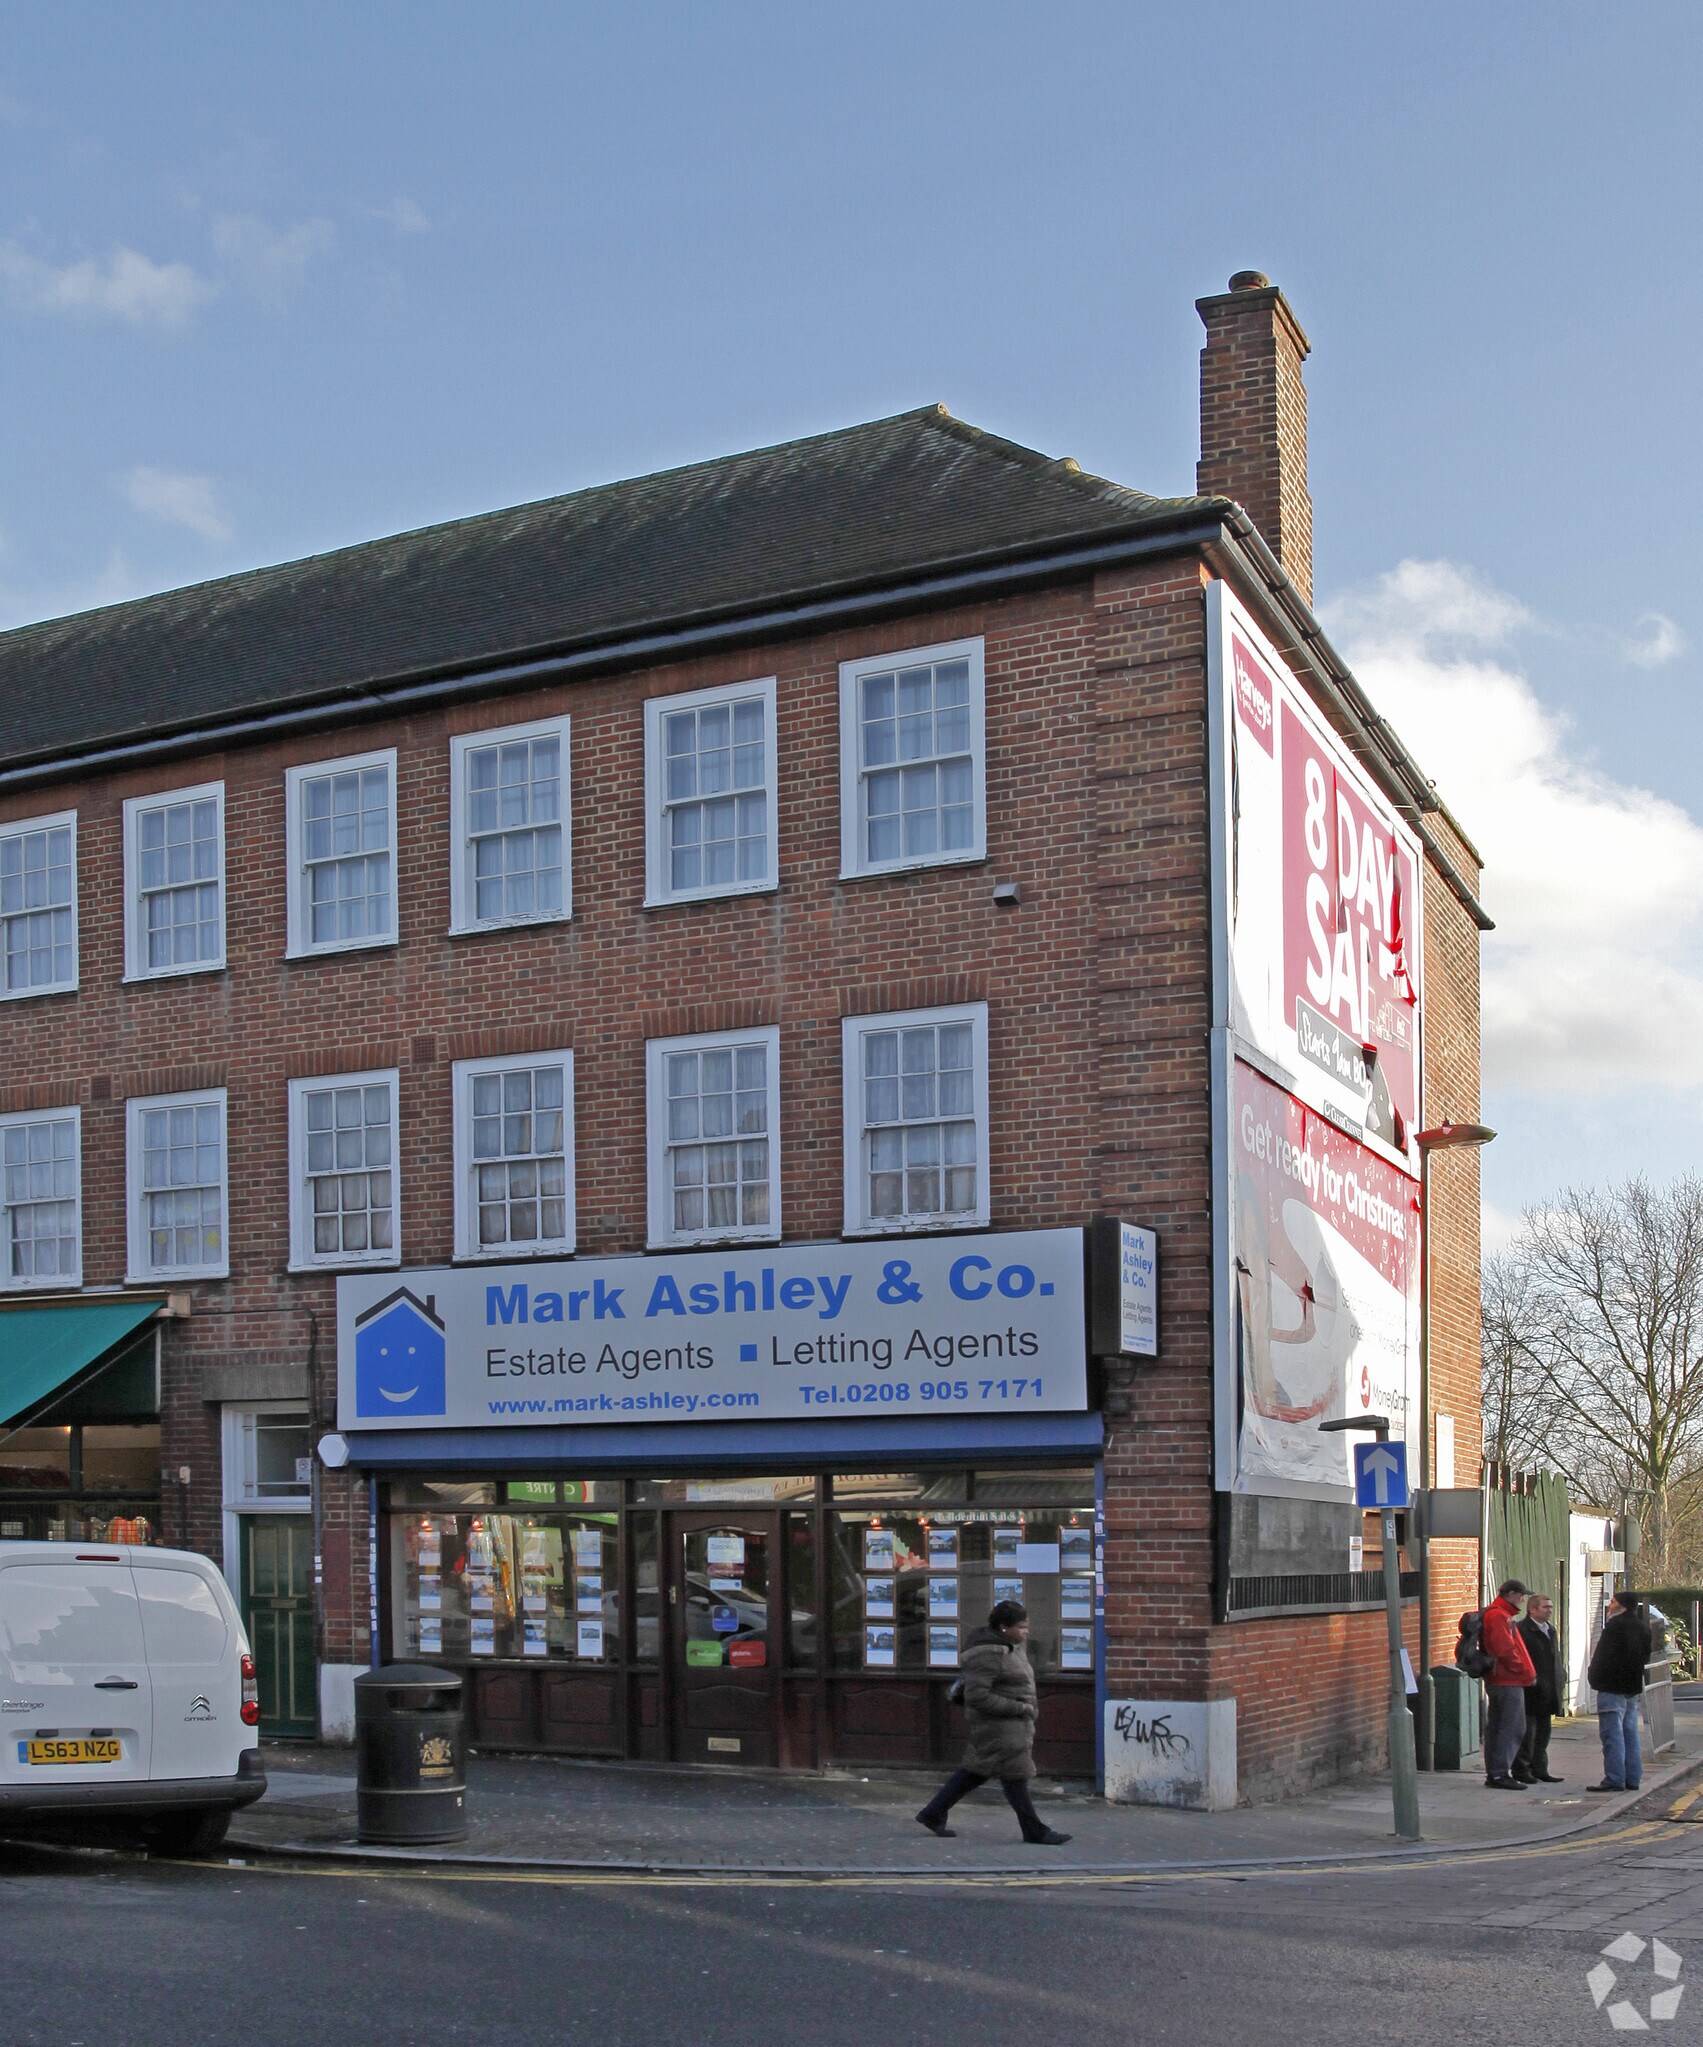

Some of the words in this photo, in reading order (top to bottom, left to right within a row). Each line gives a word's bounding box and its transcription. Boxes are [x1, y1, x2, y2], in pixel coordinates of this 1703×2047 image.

[1236, 654, 1271, 730] Harveys
[1305, 758, 1328, 871] 8
[1336, 788, 1395, 943] DAY
[1299, 1011, 1331, 1066] Starts
[1241, 1104, 1273, 1164] Get
[1276, 1134, 1320, 1202] ready
[1321, 1153, 1343, 1205] for
[1344, 1170, 1407, 1241] Christmas
[1123, 1231, 1145, 1250] Mark
[1123, 1250, 1153, 1274] Ashley
[486, 1279, 626, 1325] Mark
[644, 1268, 853, 1319] Ashley
[876, 1260, 923, 1304] &
[949, 1255, 1054, 1300] Co.
[1123, 1269, 1130, 1283] &
[1132, 1272, 1147, 1288] Co.
[487, 1346, 586, 1377] Estate
[596, 1342, 714, 1379] Agents
[772, 1332, 892, 1370] Letting
[904, 1326, 1039, 1367] Agents
[488, 1391, 759, 1413] www.mark-ashley.com
[799, 1382, 910, 1404] Tel.0208
[920, 1381, 968, 1400] 905
[978, 1378, 1042, 1399] 7171
[2, 1699, 44, 1709] Berlingo
[31, 1742, 79, 1758] LS63
[84, 1741, 118, 1756] NZG
